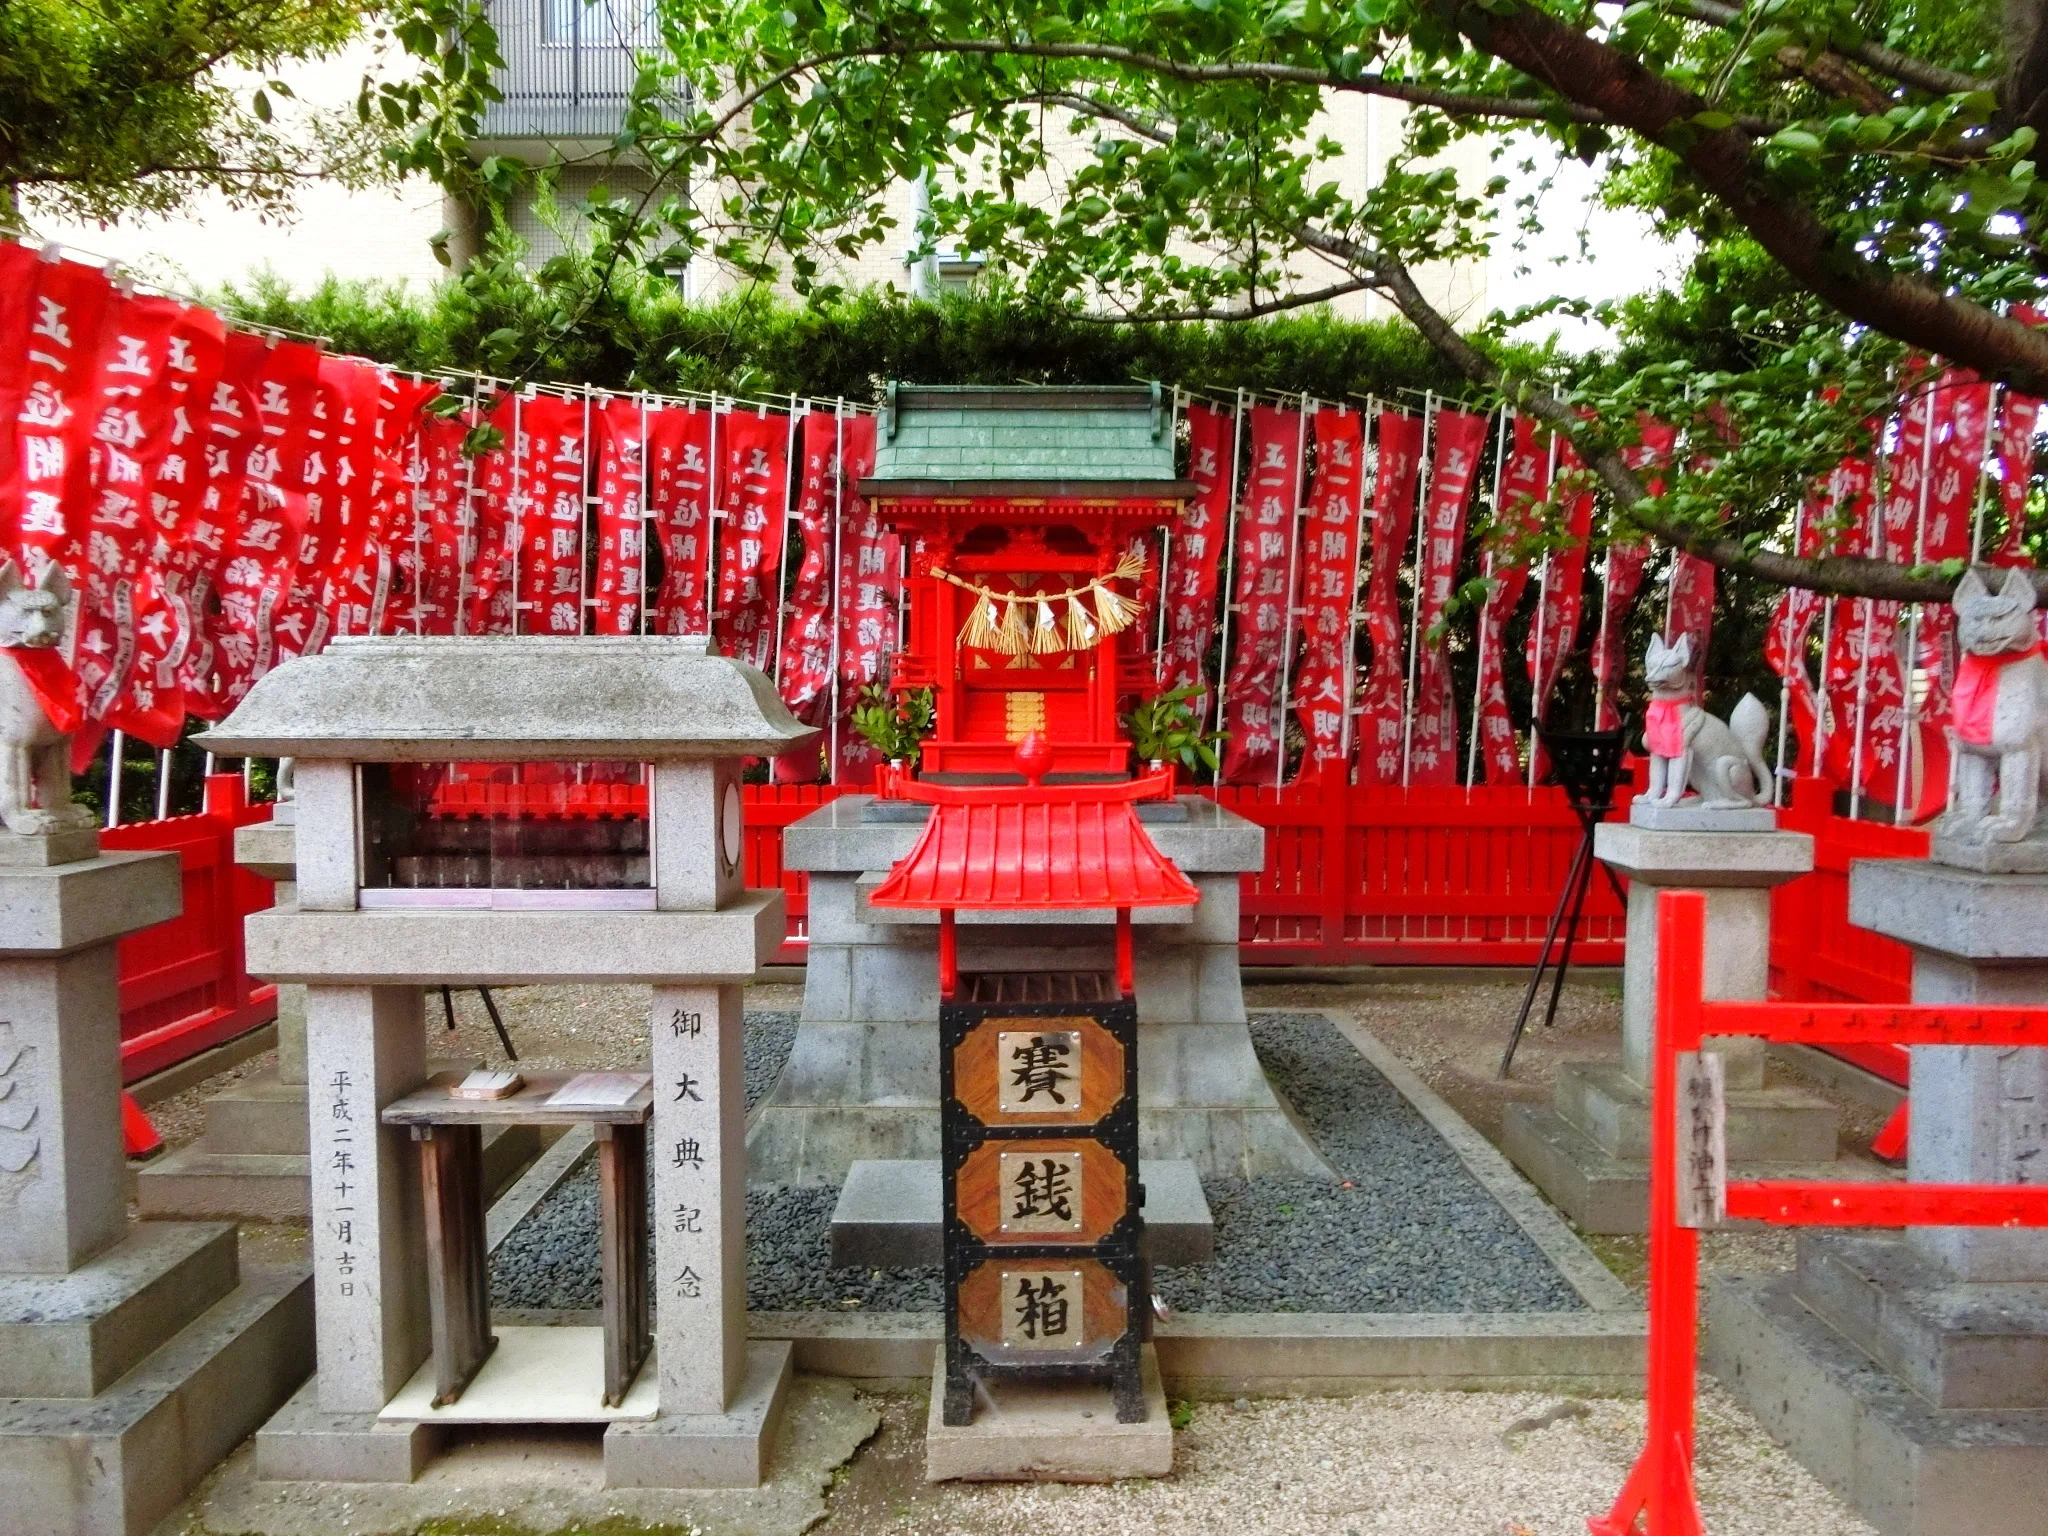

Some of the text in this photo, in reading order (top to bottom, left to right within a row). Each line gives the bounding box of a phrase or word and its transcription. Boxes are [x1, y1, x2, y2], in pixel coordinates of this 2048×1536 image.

[328, 1069, 356, 1298] 平成二年十一月吉日
[670, 1007, 706, 1301] 御大典記念
[1009, 1035, 1075, 1342] 賽銭箱
